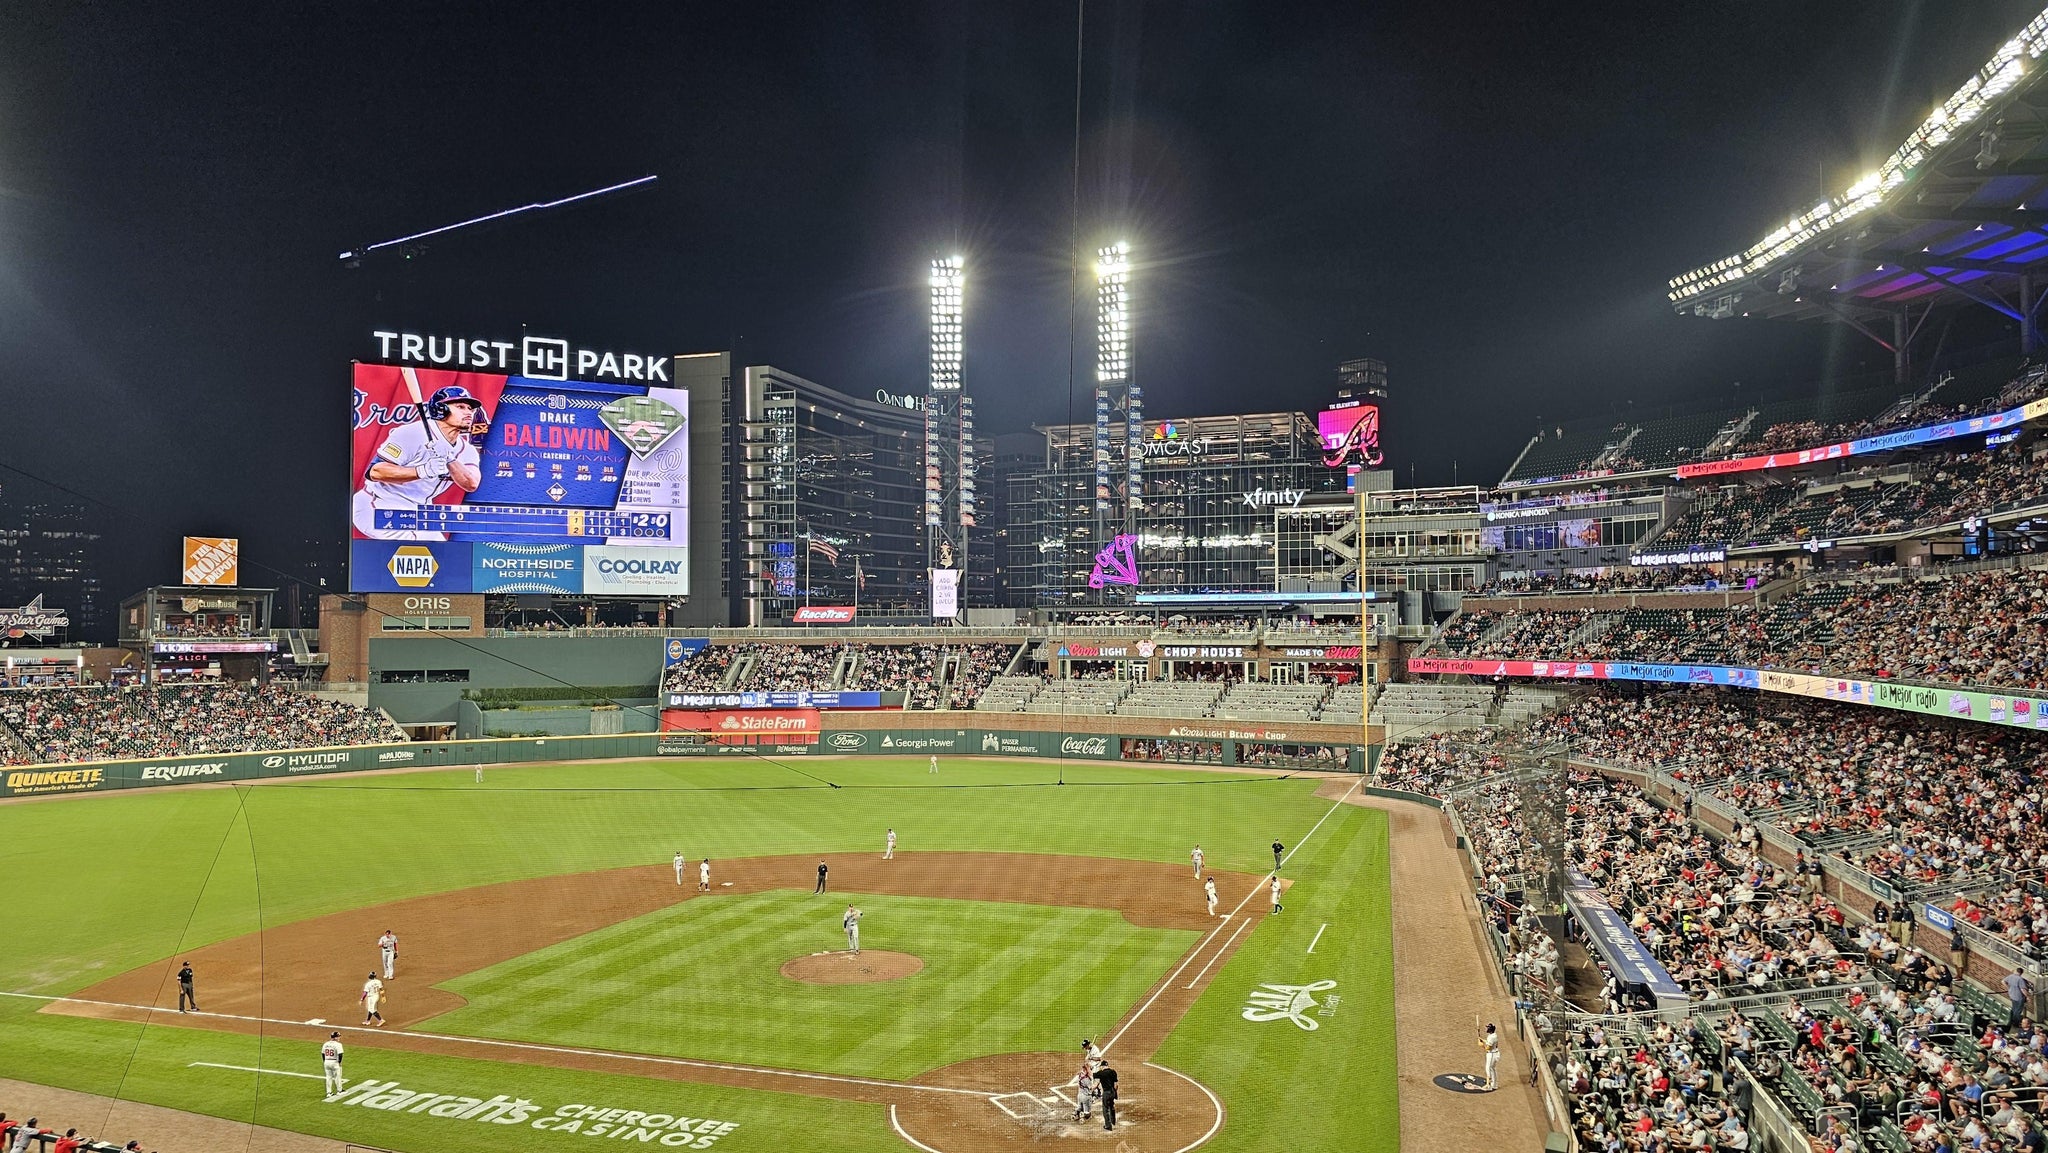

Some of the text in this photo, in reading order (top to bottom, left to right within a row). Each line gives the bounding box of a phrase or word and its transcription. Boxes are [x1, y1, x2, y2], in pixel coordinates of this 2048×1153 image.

[374, 331, 669, 381] TRUIST PARK
[548, 394, 566, 410] 30
[876, 389, 904, 408] OMNI
[540, 412, 576, 424] DRAKE
[504, 424, 610, 452] BALDWIN
[1870, 436, 1894, 447] Mejor
[1894, 432, 1915, 442] radio
[1692, 463, 1718, 473] Mejor
[1720, 460, 1742, 470] radio
[1242, 487, 1304, 511] xfinity
[638, 514, 648, 527] 2
[656, 515, 668, 528] 0
[1495, 509, 1549, 520] KONICA MINOLTA
[185, 540, 236, 583] HOME
[483, 558, 574, 570] NORTHSIDE
[1642, 554, 1667, 565] Mejor
[1668, 552, 1690, 564] radio
[1709, 551, 1724, 561] PM
[204, 555, 237, 584] DEPOT
[397, 557, 430, 575] NAPA
[598, 559, 683, 574] COOLRAY
[500, 571, 557, 579] HOSPITAL
[199, 600, 237, 609] CLUBHOUSE
[404, 597, 451, 609] ORIS
[8, 614, 69, 628] Star Game
[799, 610, 849, 619] RaceTrac
[1069, 643, 1128, 656] Coors LIGHT
[1164, 647, 1243, 657] CHOP HOUSE
[1324, 646, 1362, 659] Chill
[1423, 661, 1449, 671] Mejor
[1451, 661, 1473, 671] radio
[1631, 665, 1653, 679] Mejor
[1655, 667, 1674, 678] radio
[683, 695, 714, 706] Mejor
[715, 695, 740, 705] radio
[1889, 685, 1912, 708] Mejor
[1916, 690, 1937, 709] radio
[741, 717, 806, 729] State Farm
[834, 734, 860, 746] Ford
[1180, 726, 1287, 740] Coors LIGHT BELOW CHOP
[896, 739, 954, 748] Georgia Power
[1062, 736, 1108, 755] Coca-Cola
[289, 752, 350, 766] HYUNDAI
[142, 763, 225, 781] EQUIFAX
[289, 764, 337, 773] HyundaiUSA.com
[7, 769, 103, 788] QUIKRETE
[1928, 909, 1949, 927] GEICO
[323, 1079, 542, 1125] Harrah's
[554, 1103, 741, 1137] CHEROKEE
[531, 1116, 721, 1150] CASINOS
